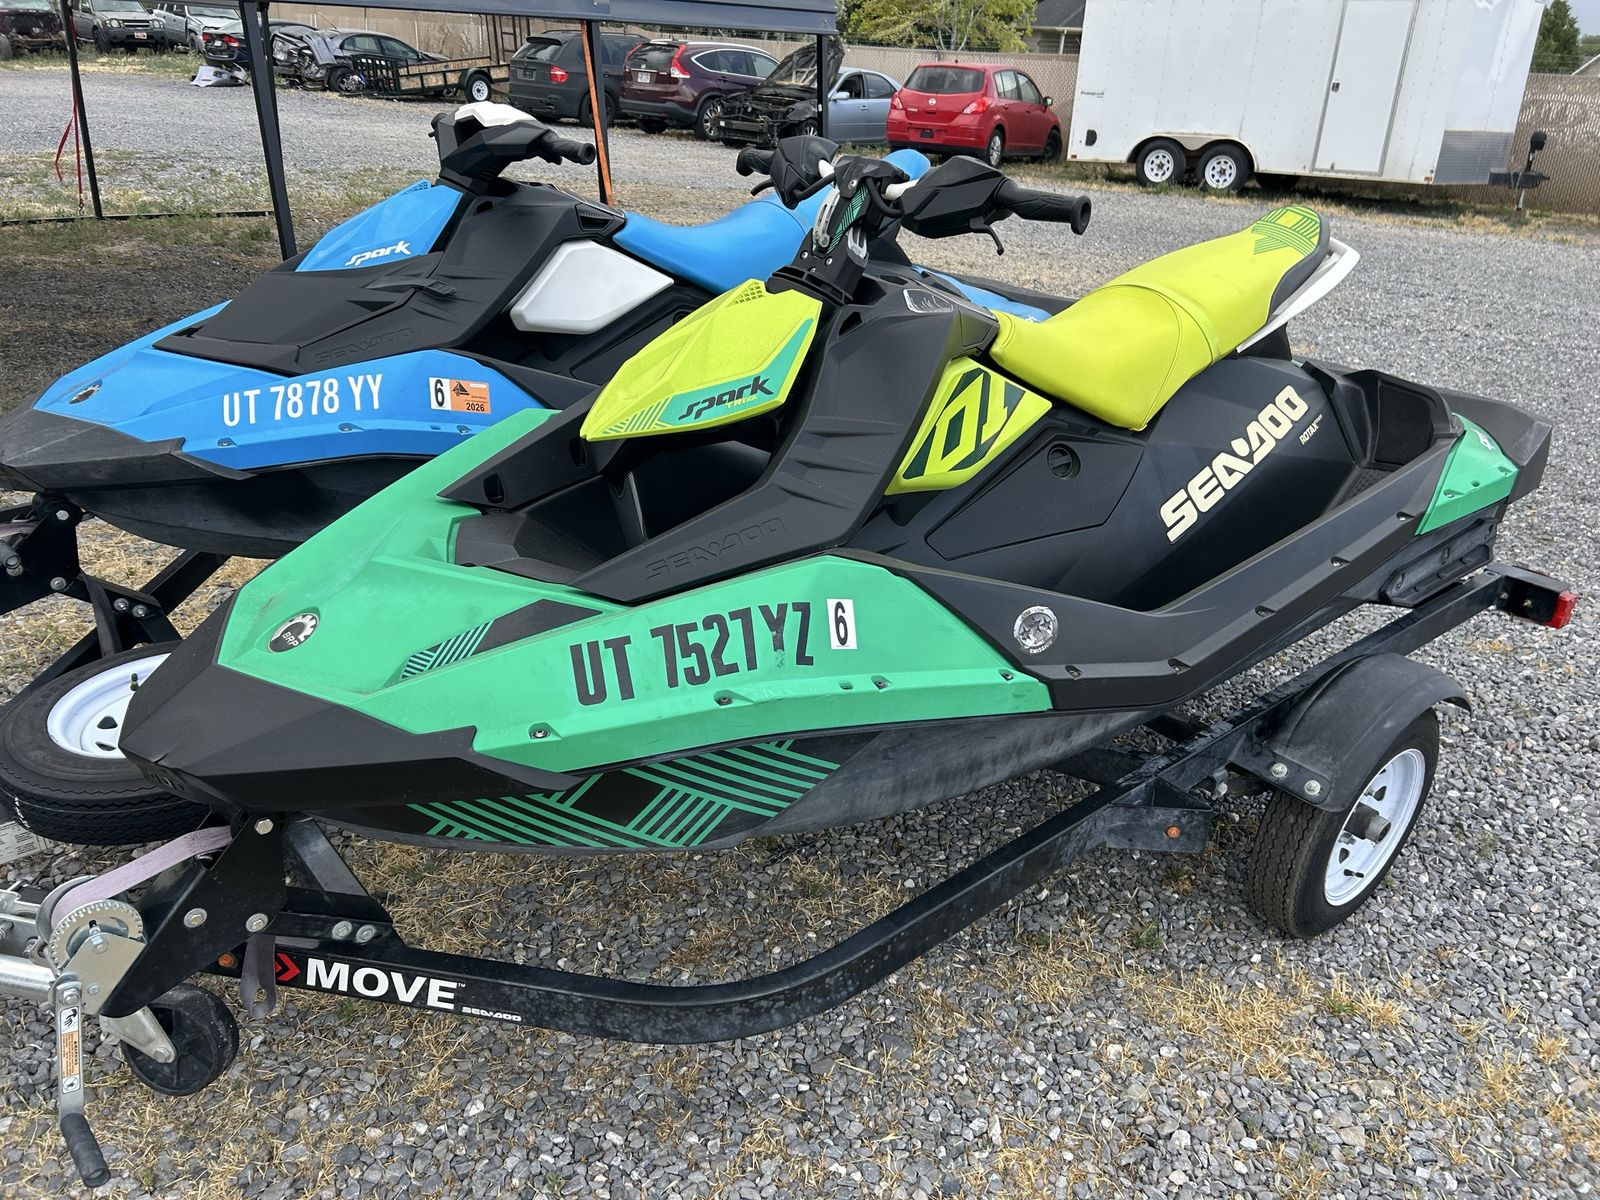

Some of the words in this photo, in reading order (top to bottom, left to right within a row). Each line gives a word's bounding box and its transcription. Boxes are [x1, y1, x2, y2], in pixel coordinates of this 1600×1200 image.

[344, 240, 412, 266] spark
[223, 389, 261, 427] UT
[269, 378, 340, 420] 7878
[347, 374, 383, 411] YY
[434, 379, 445, 407] 6
[465, 402, 485, 412] 2026
[678, 375, 774, 420] spark
[1299, 421, 1319, 445] ROTAX
[282, 631, 299, 646] BRP
[834, 601, 849, 647] 6
[569, 635, 635, 706] UT
[306, 957, 458, 1010] MOVE
